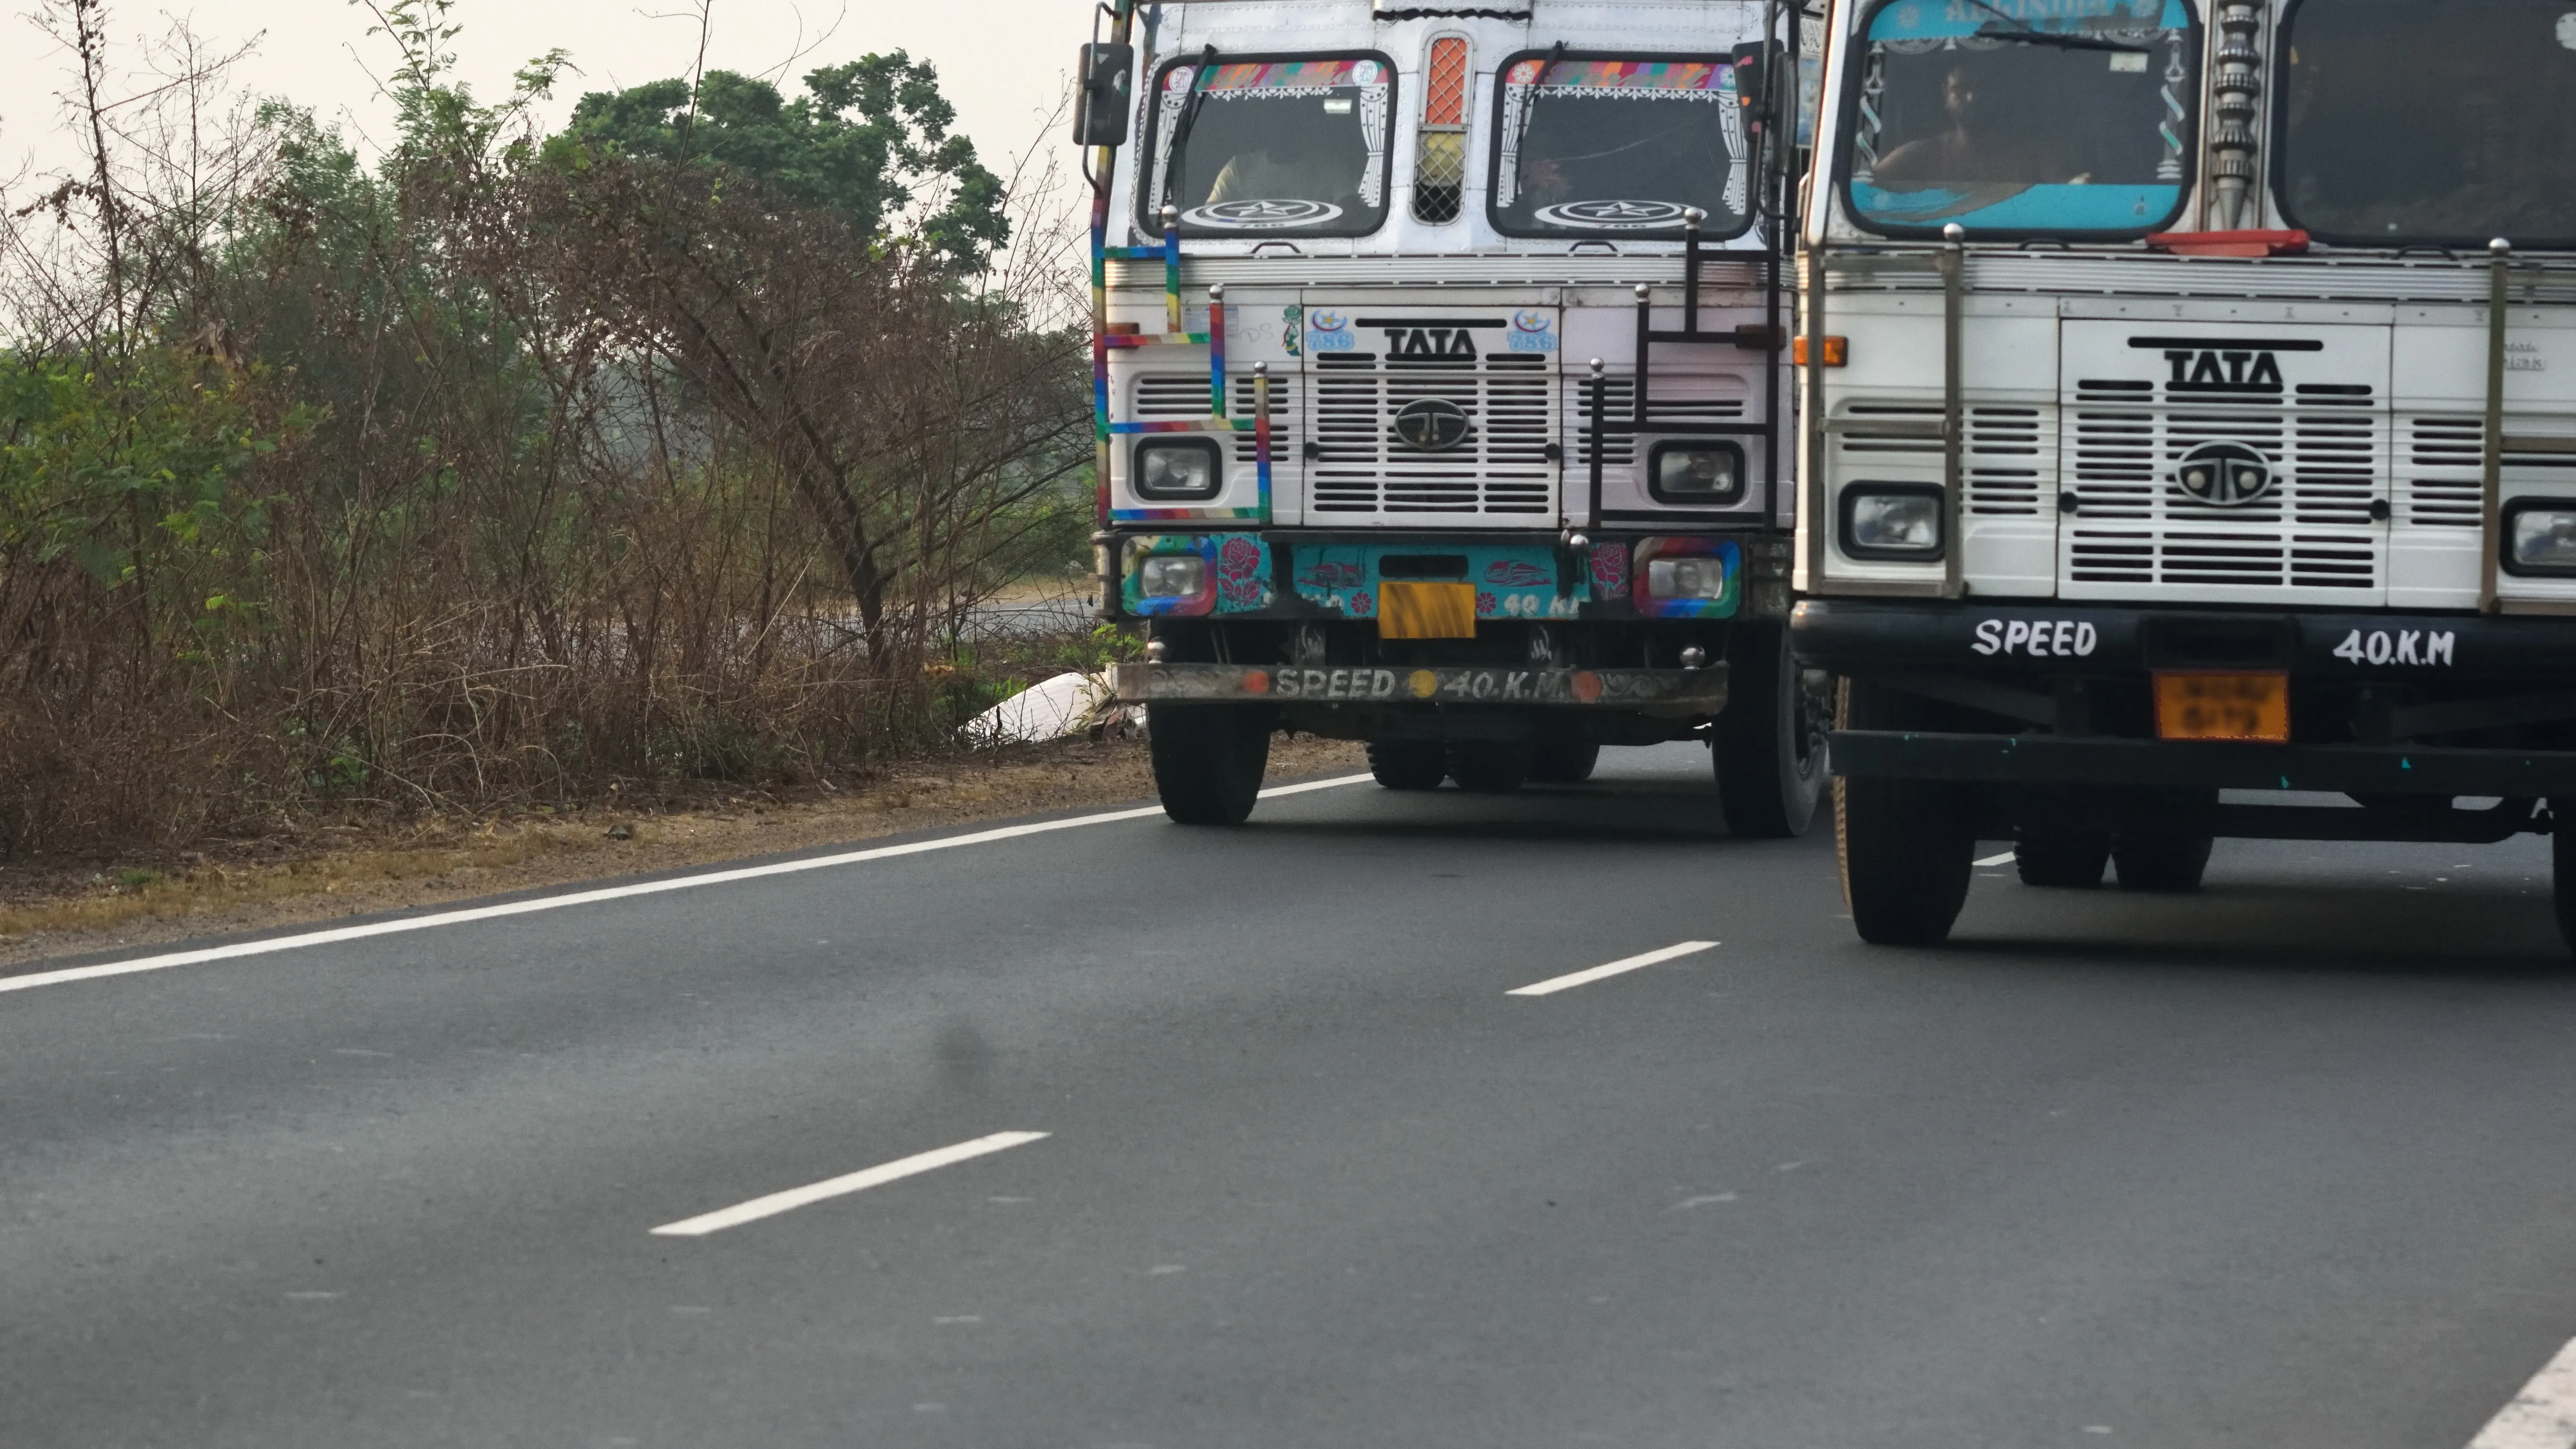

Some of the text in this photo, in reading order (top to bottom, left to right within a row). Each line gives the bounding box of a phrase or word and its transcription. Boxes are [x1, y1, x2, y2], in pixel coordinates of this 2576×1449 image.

[1306, 331, 1355, 351] 786
[1384, 328, 1477, 354] TATA
[1507, 331, 1559, 352] 786
[2164, 351, 2283, 383] TATA
[1970, 619, 2455, 667] SPEED 40.K.M
[1276, 669, 1396, 698] SPEED
